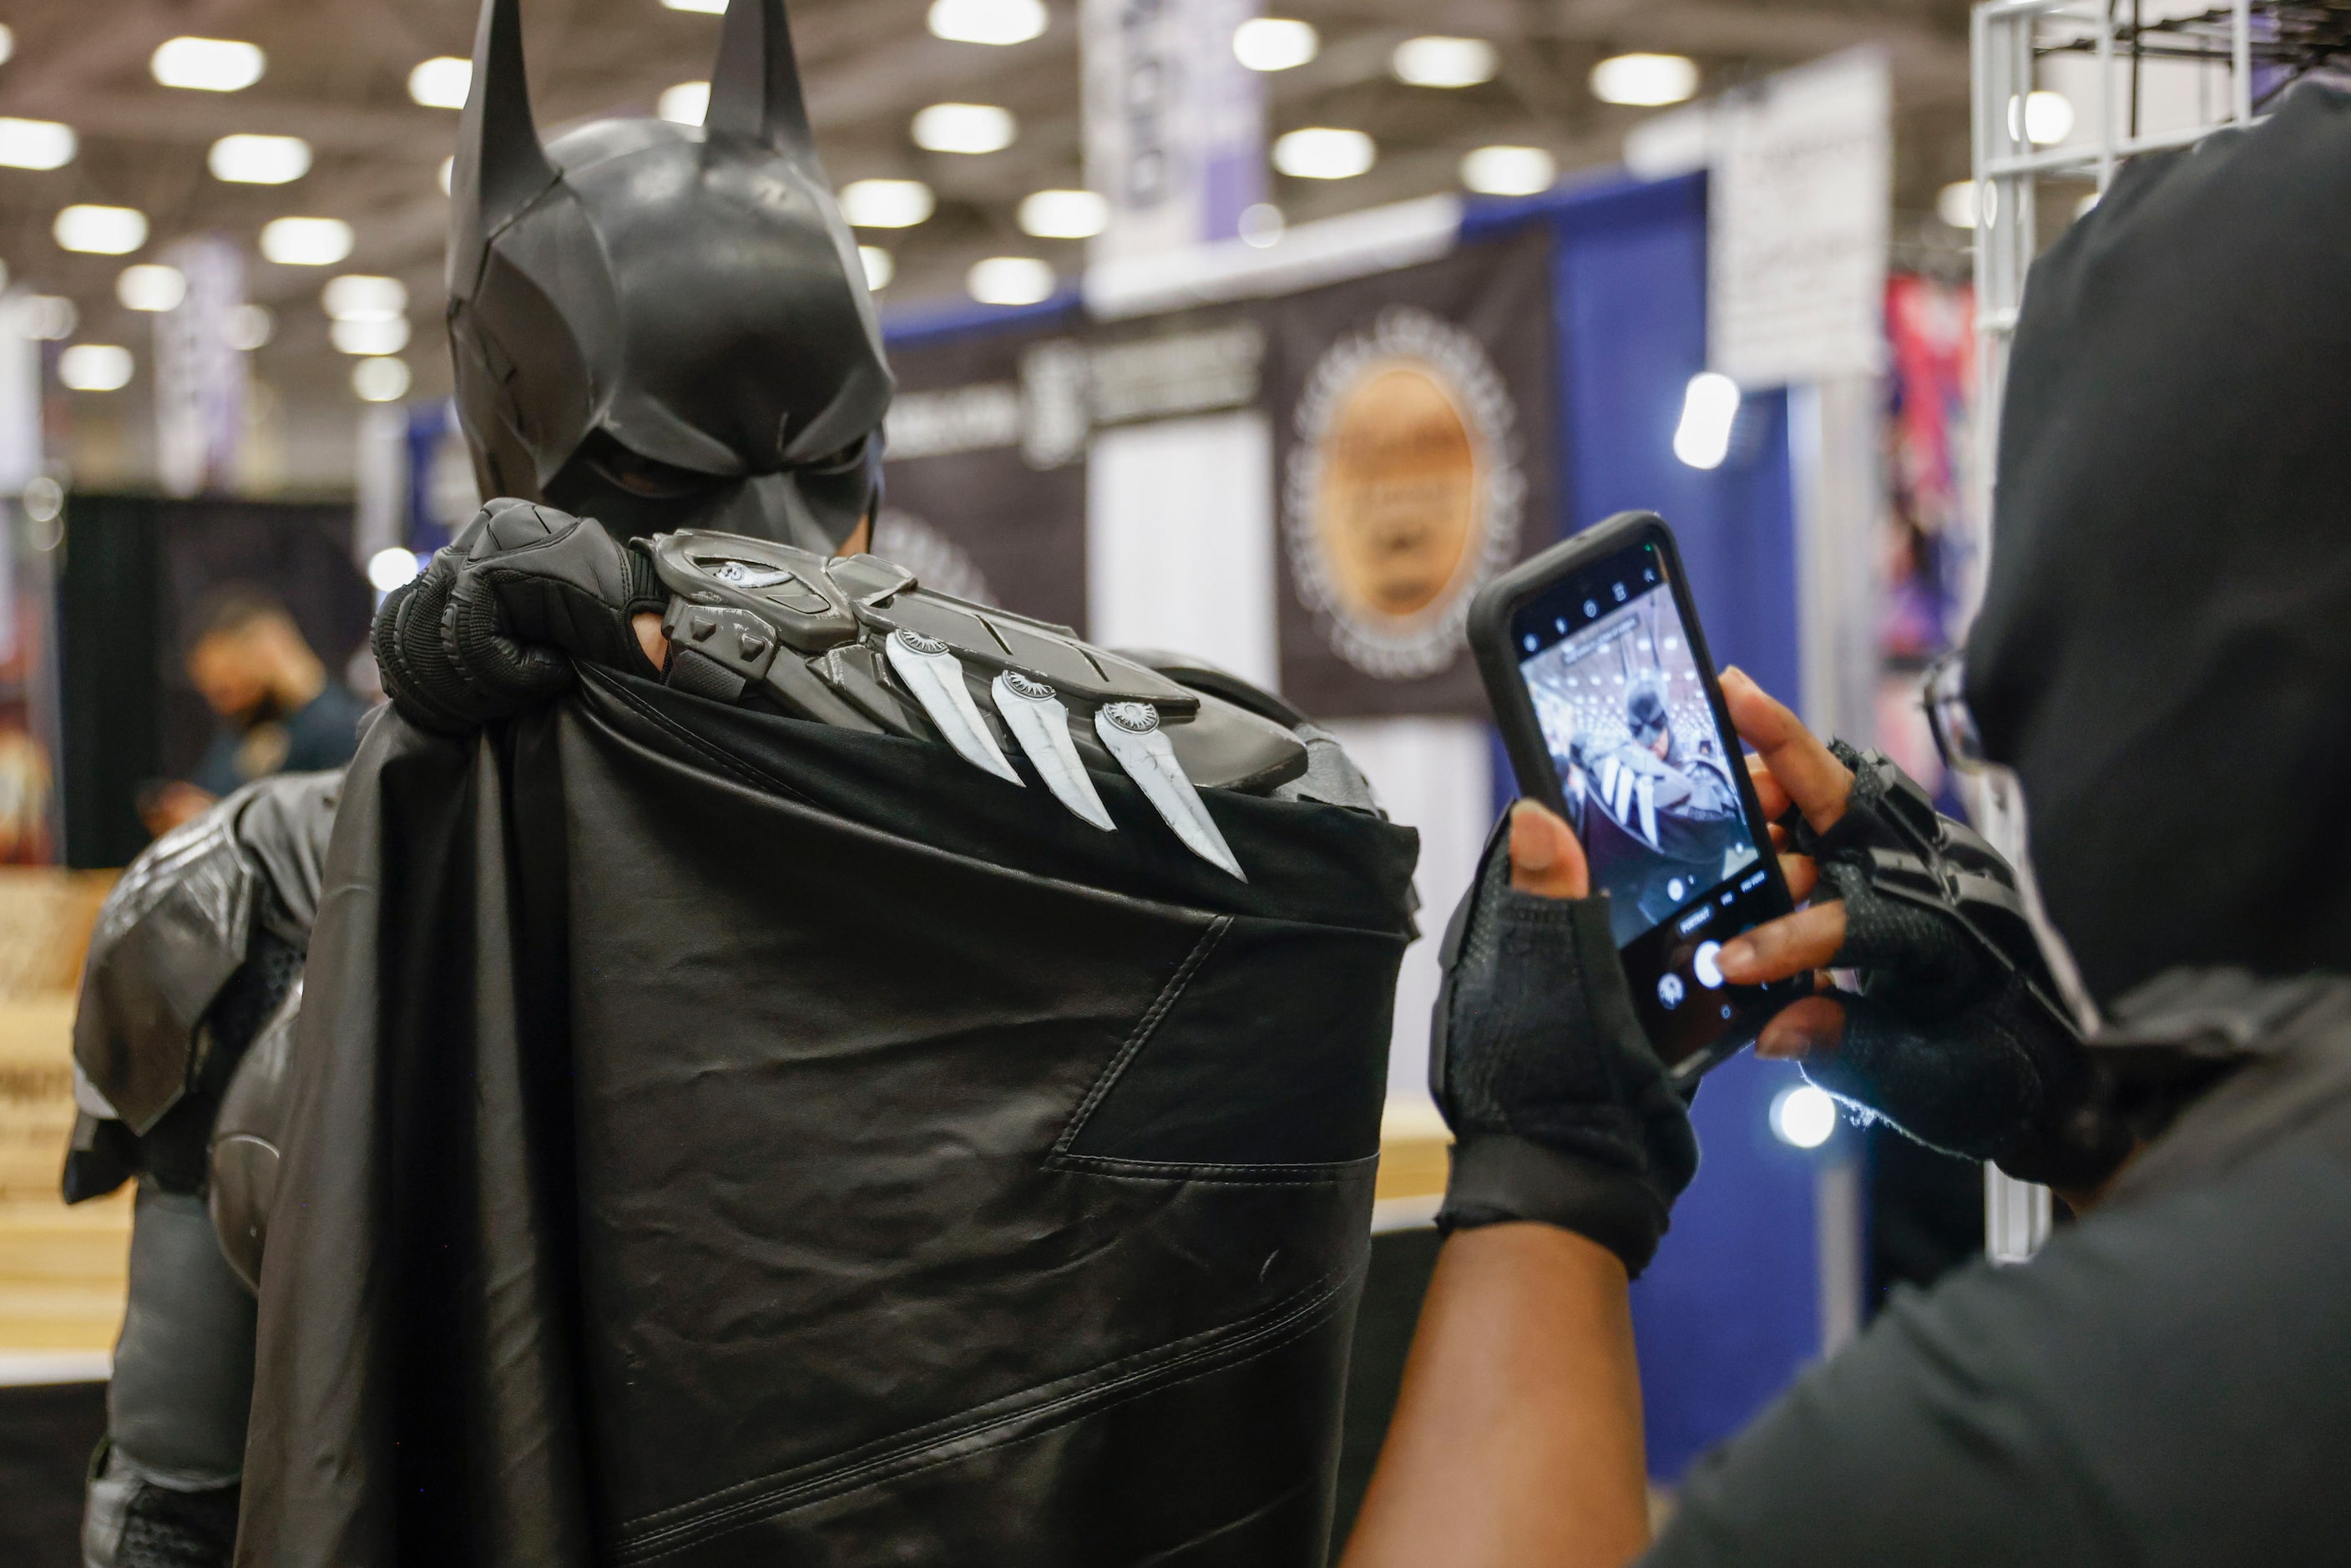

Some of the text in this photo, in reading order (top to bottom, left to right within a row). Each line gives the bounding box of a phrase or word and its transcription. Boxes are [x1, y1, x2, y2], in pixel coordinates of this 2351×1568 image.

[1680, 871, 1765, 933] PORTRAIT PRO PRO VIDEO
